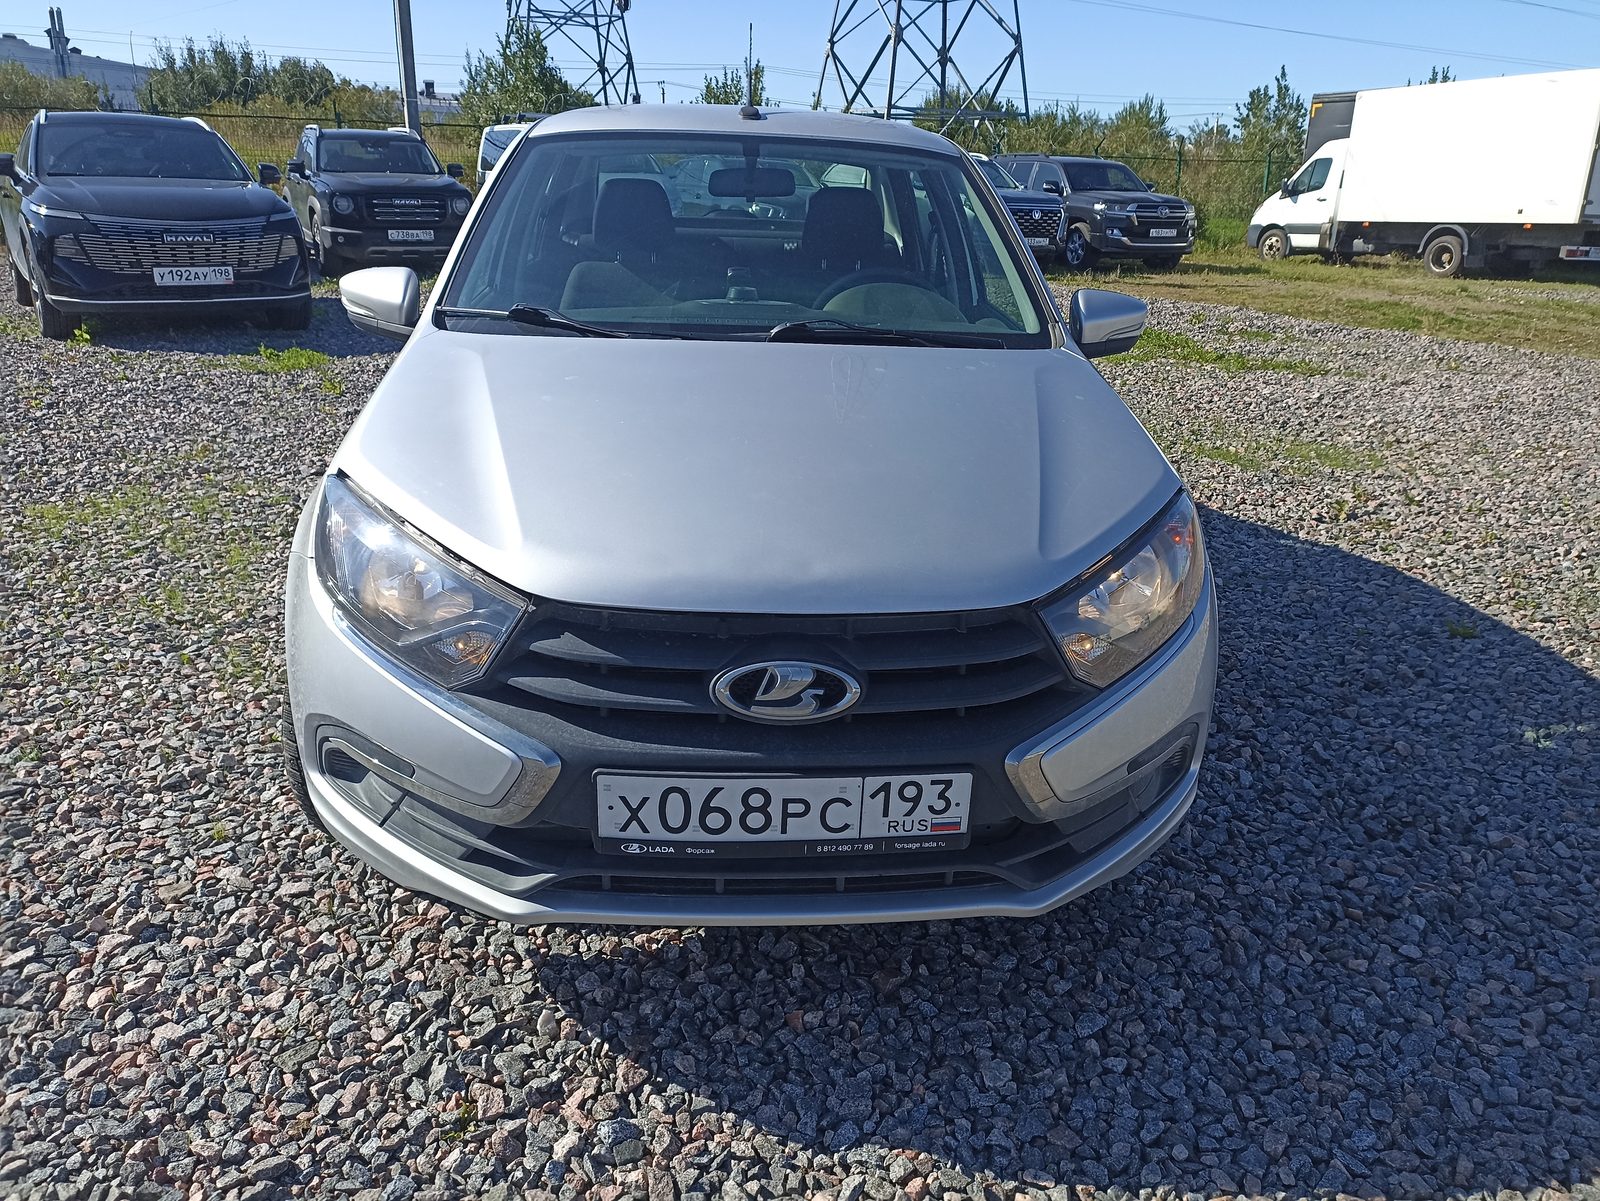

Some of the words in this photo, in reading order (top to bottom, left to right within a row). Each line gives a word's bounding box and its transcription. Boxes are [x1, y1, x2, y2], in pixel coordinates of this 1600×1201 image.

[166, 234, 211, 242] HAVAL
[210, 268, 230, 280] 198
[869, 779, 954, 818] 193
[887, 818, 928, 833] RUS
[648, 845, 675, 854] LADA
